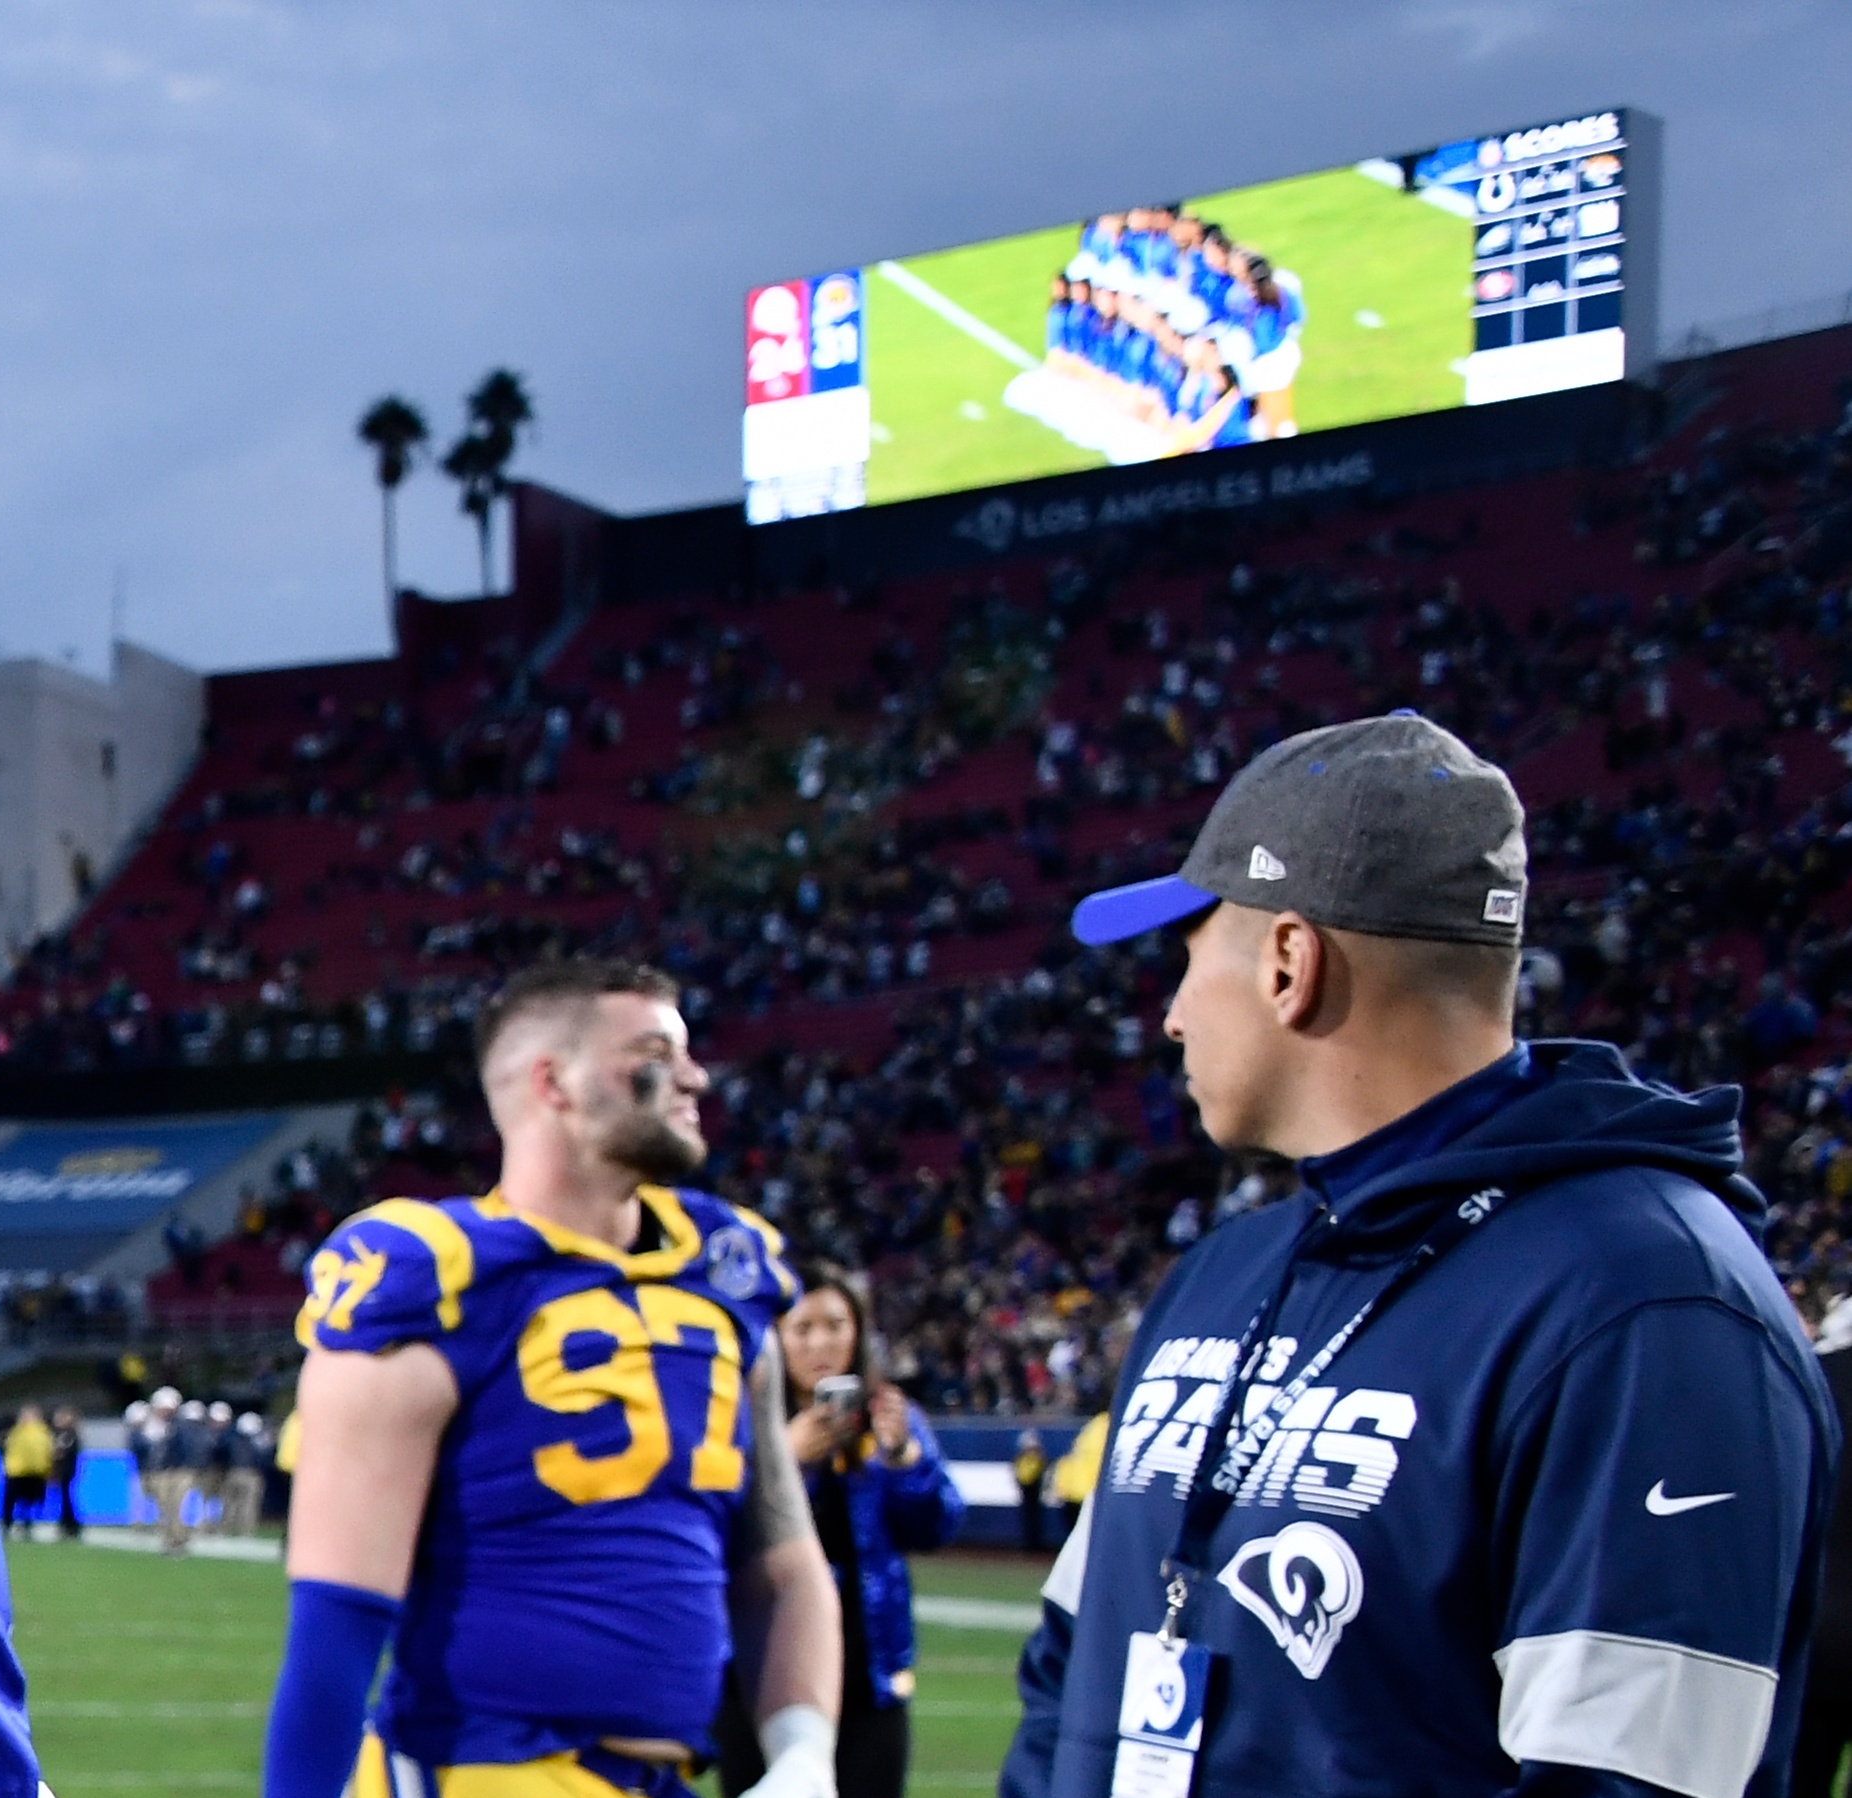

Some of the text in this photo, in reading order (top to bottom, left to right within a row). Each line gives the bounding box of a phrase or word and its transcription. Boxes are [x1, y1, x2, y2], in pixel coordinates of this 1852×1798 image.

[1021, 502, 1089, 538] LOS
[295, 1236, 387, 1349] 97
[517, 1283, 745, 1507] 97
[1111, 1379, 1418, 1519] RAMS
